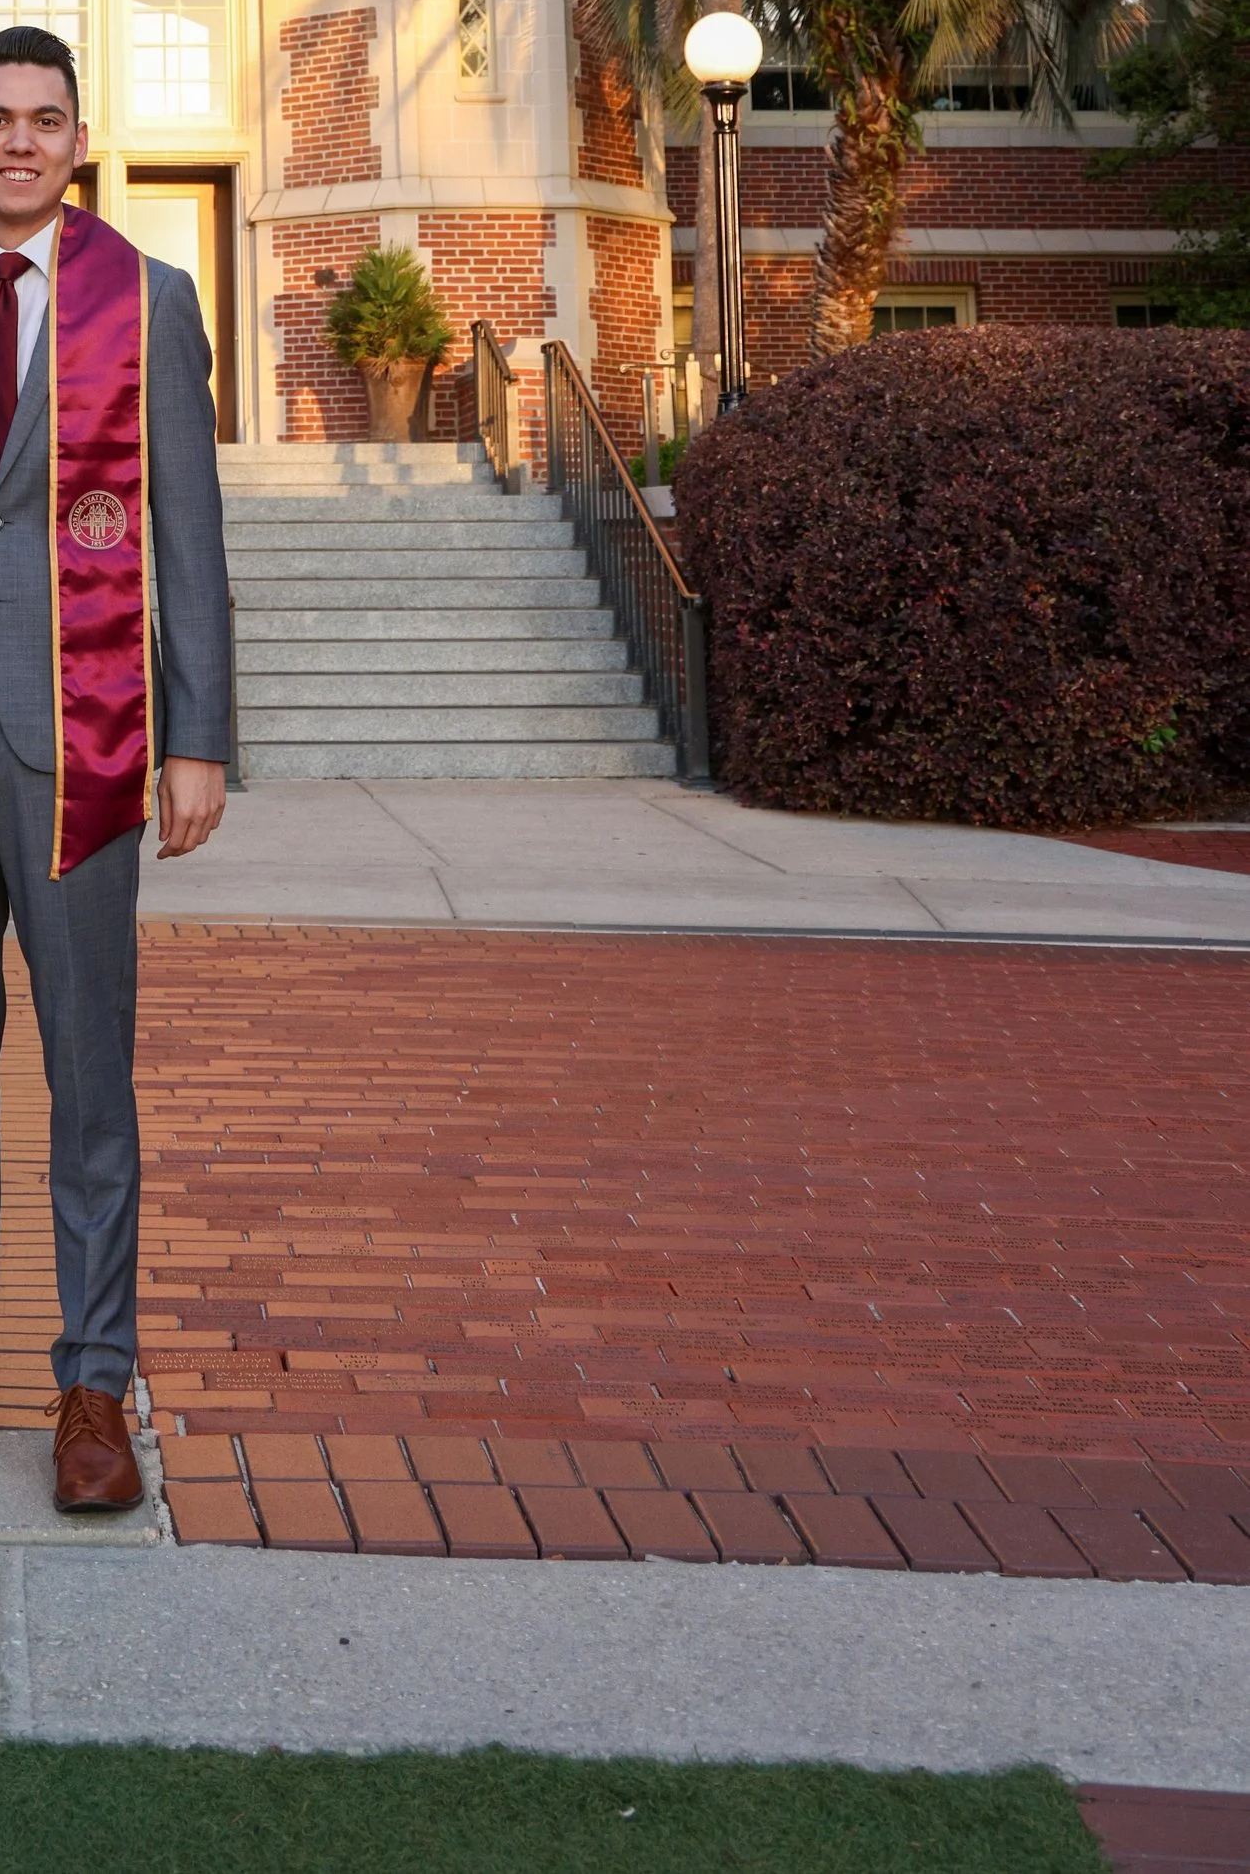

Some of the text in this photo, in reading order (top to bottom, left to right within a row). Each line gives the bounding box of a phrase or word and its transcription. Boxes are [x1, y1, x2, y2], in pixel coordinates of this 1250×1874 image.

[72, 494, 124, 537] FLORIDA STATE UNIVERSITY
